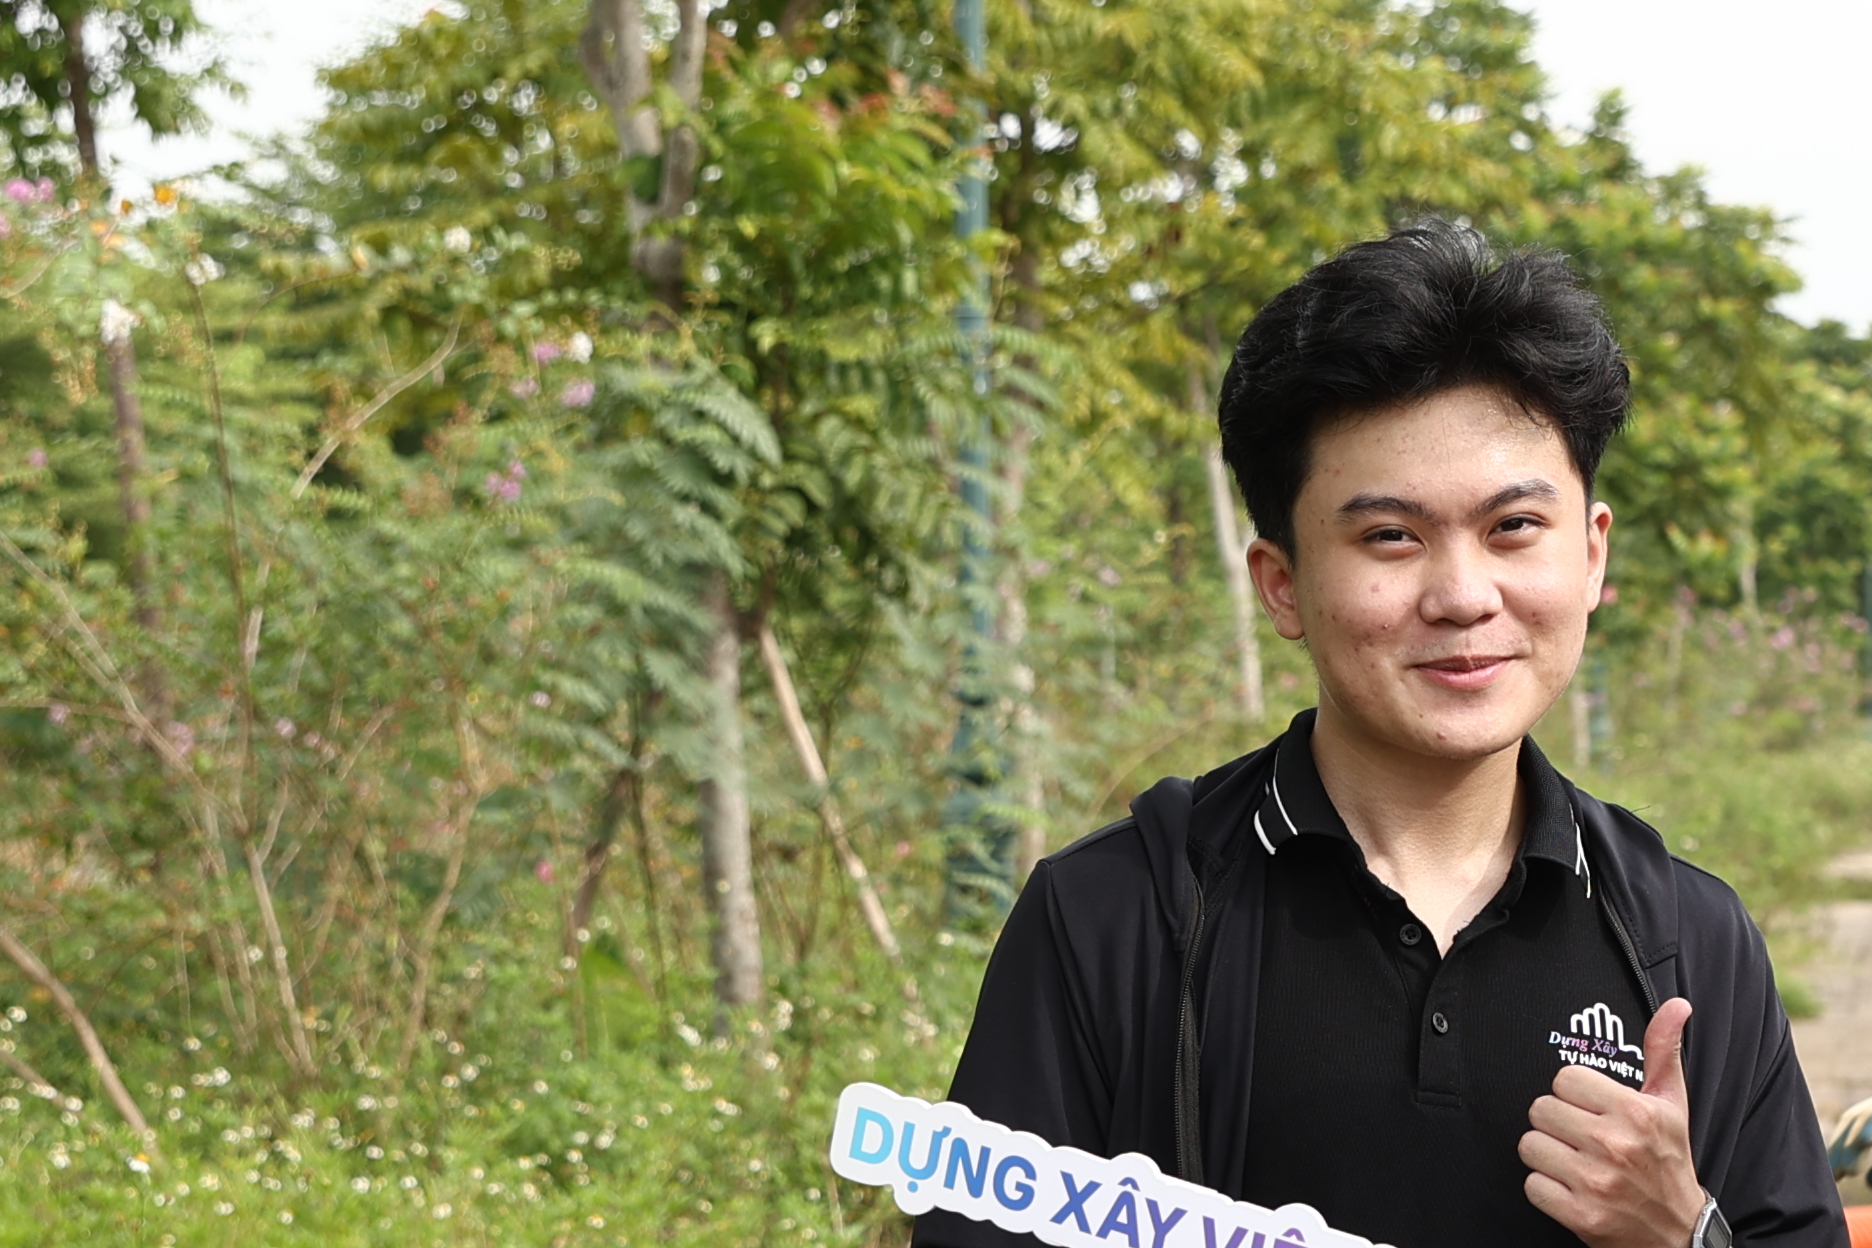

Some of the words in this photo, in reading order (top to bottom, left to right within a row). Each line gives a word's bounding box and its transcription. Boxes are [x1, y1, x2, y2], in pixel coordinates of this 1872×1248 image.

[1548, 1031, 1589, 1052] Dựng
[1592, 1038, 1617, 1057] Xây
[1558, 1049, 1578, 1065] TỰ
[1579, 1053, 1607, 1068] HÀO
[1609, 1060, 1634, 1078] VIỆT
[849, 1106, 1037, 1211] DỰNG
